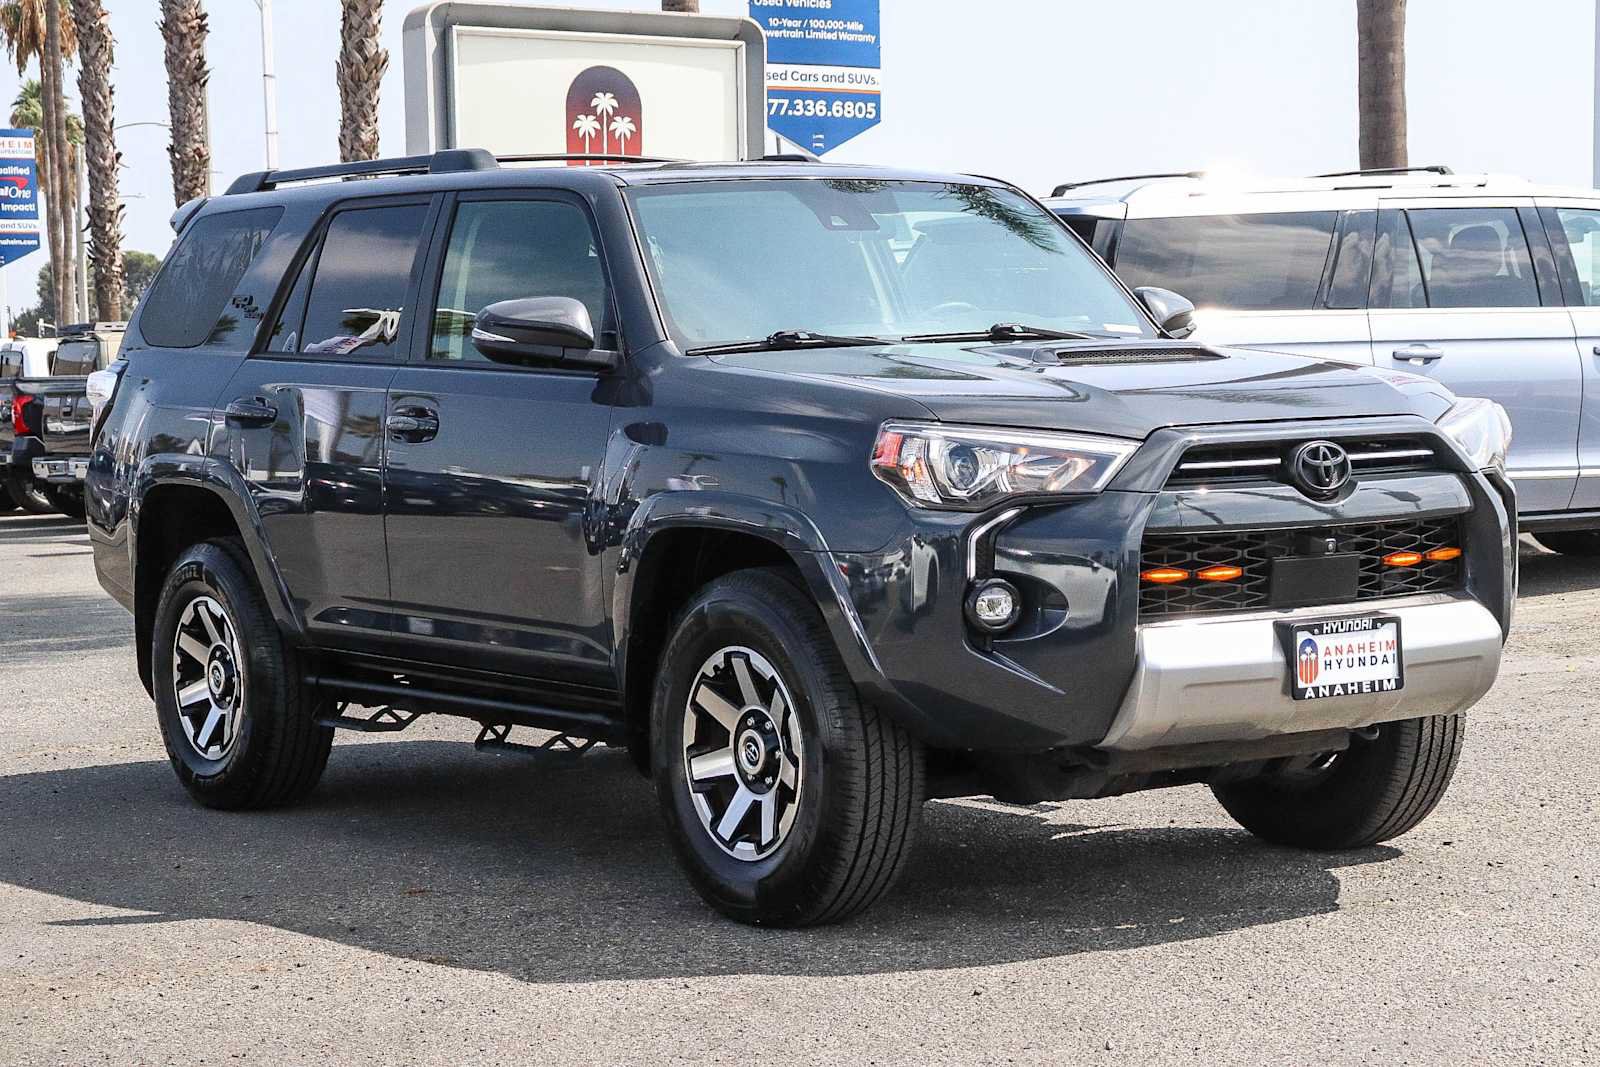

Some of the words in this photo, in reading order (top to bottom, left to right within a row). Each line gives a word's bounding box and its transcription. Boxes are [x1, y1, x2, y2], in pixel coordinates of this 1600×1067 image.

[786, 0, 832, 9] Vehicles
[768, 18, 802, 27] 10-Year
[809, 19, 864, 31] 100,000-Mile
[805, 30, 837, 40] Limited
[838, 32, 876, 44] Warranty
[791, 71, 819, 83] Cars
[822, 73, 845, 84] and
[767, 98, 877, 119] 77.336.6805
[1323, 618, 1373, 634] HYUNDAI
[1324, 639, 1396, 657] ANAHEIM
[1324, 652, 1396, 671] HYUNDAI
[1305, 678, 1397, 699] ANAHEIM
